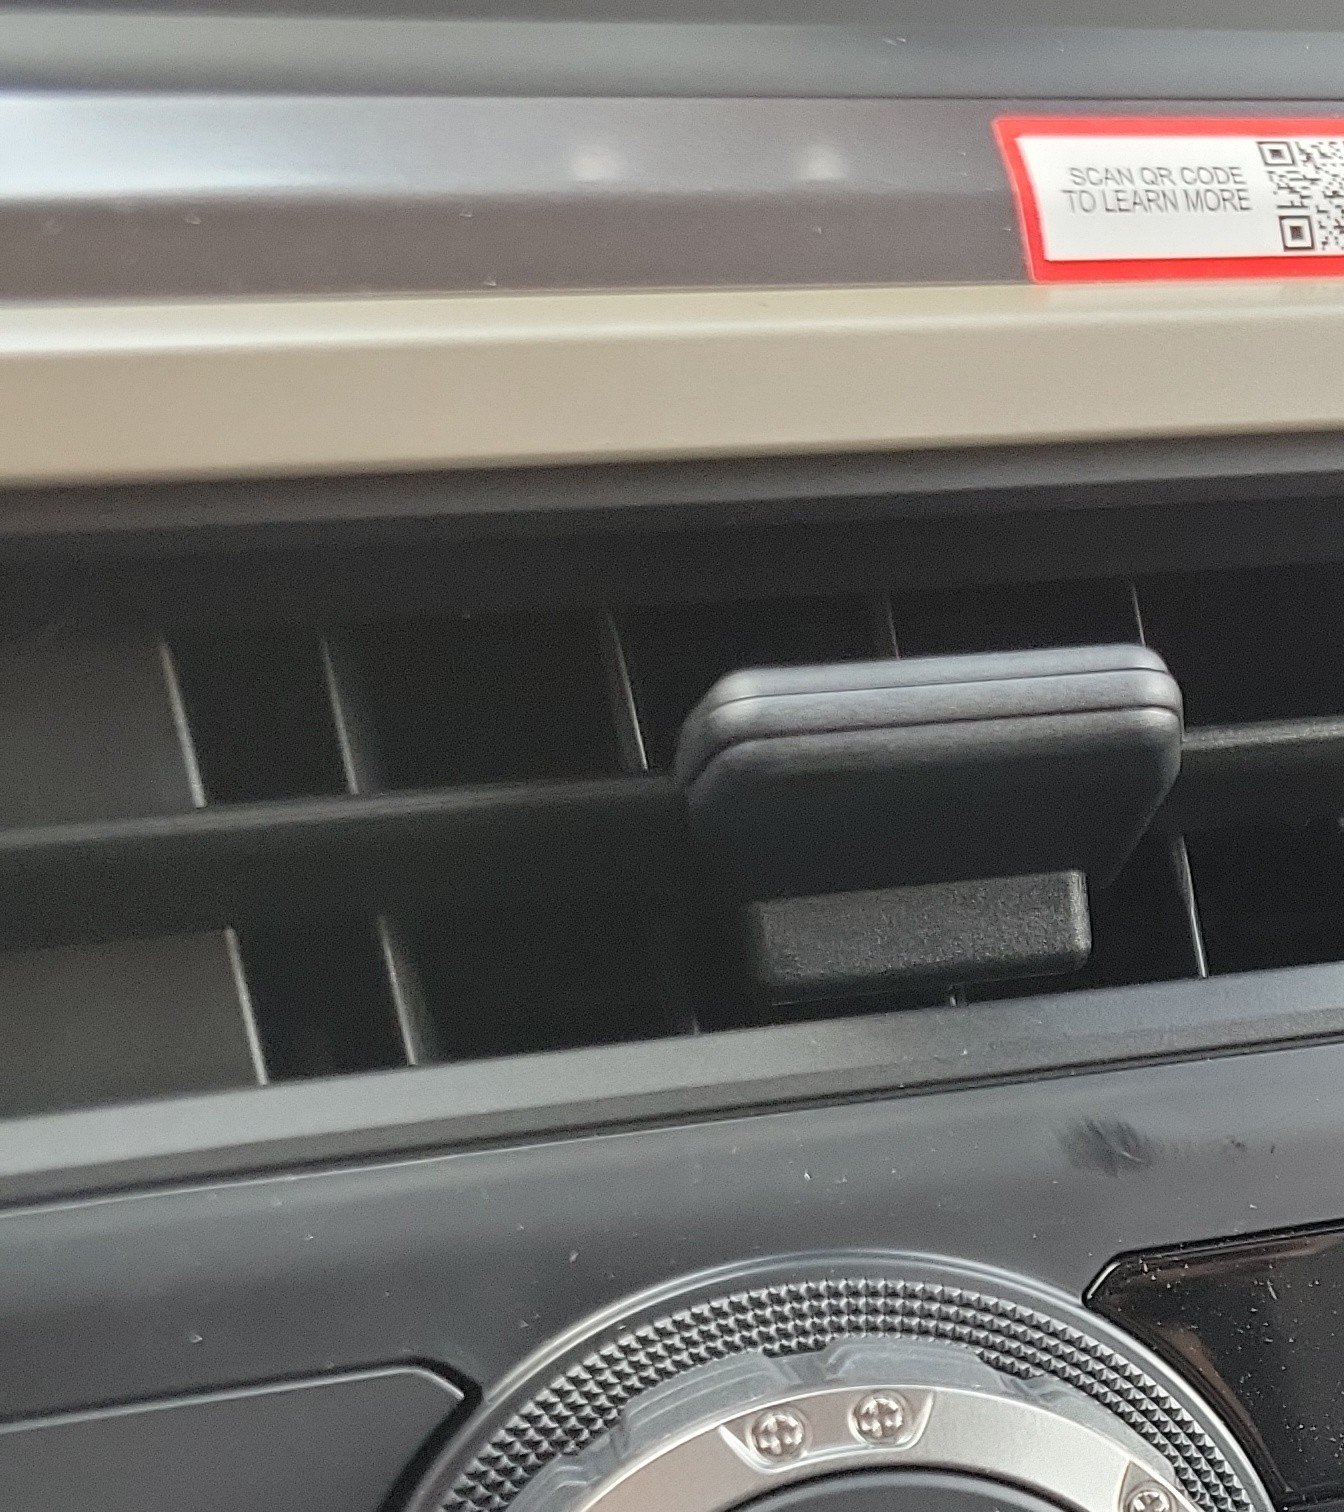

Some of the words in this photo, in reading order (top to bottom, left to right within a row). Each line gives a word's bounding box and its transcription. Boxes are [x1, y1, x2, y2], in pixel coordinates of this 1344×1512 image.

[1069, 166, 1136, 187] SCAN
[1141, 166, 1174, 187] QR
[1180, 165, 1246, 186] CODE
[1062, 188, 1096, 214] TO
[1104, 188, 1181, 213] LEARN
[1186, 188, 1253, 212] MORE
